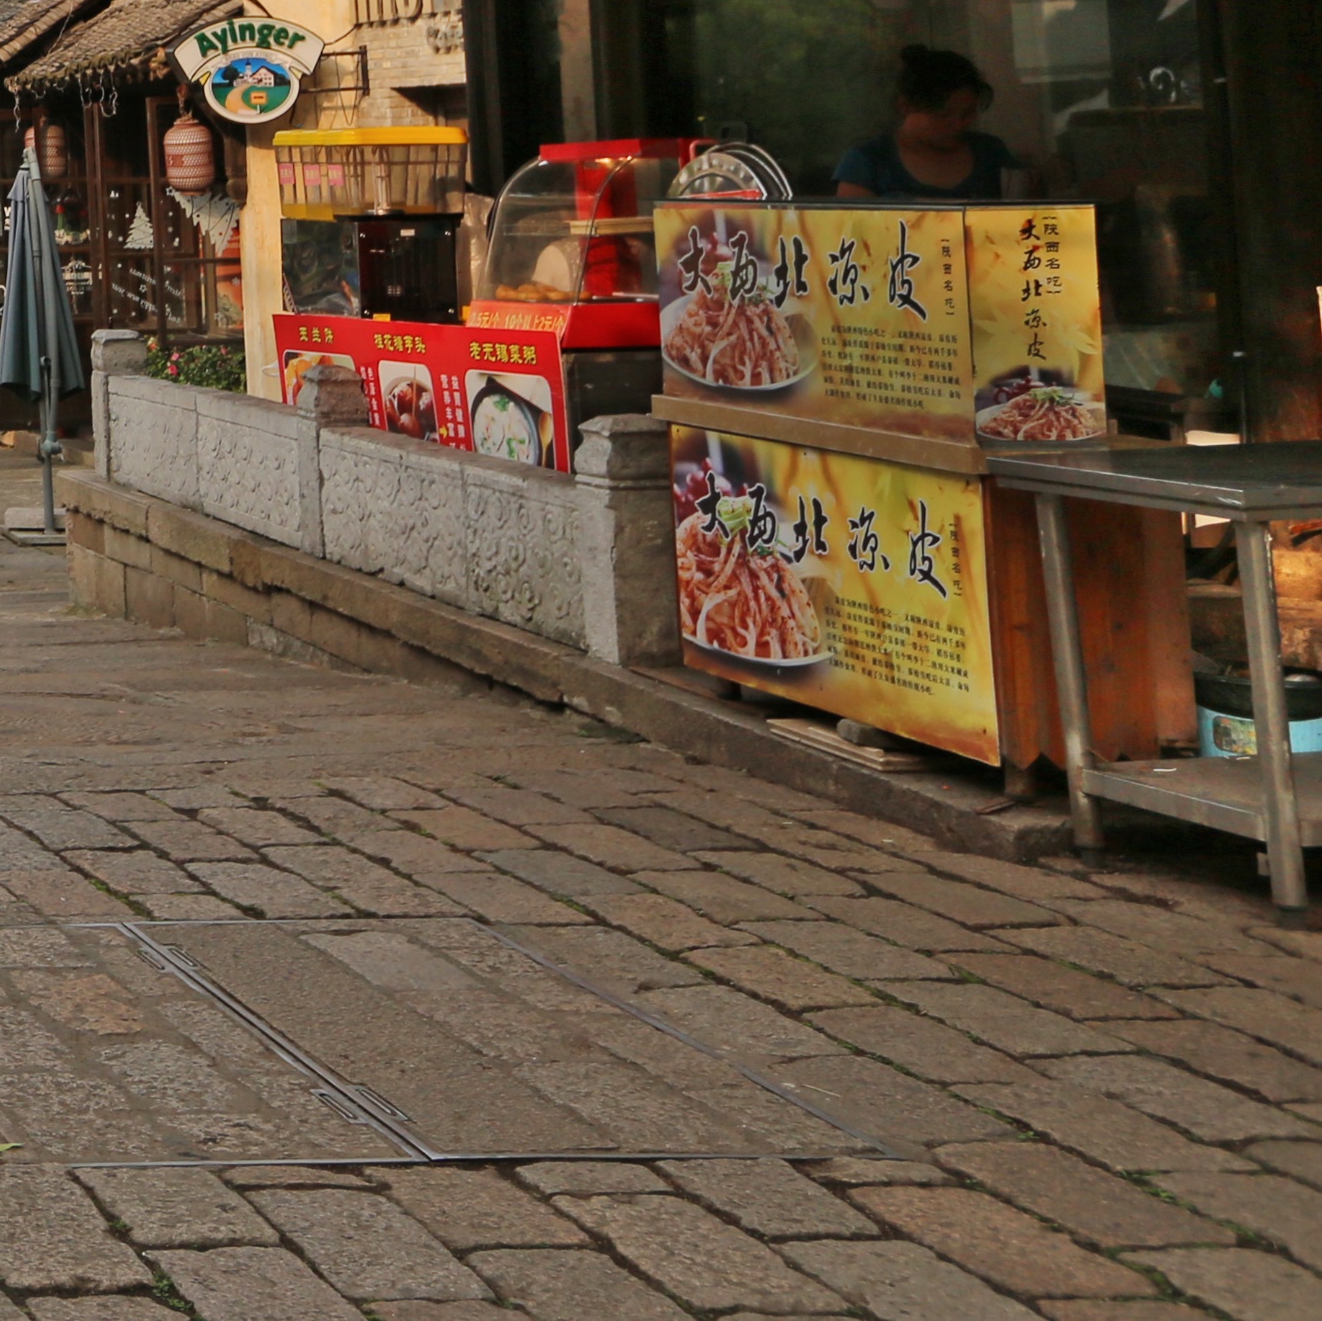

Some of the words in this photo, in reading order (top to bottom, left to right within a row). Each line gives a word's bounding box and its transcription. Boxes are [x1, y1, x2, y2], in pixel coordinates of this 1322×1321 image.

[195, 20, 306, 58] Ayinger
[469, 341, 537, 366] 老无锡菜粥
